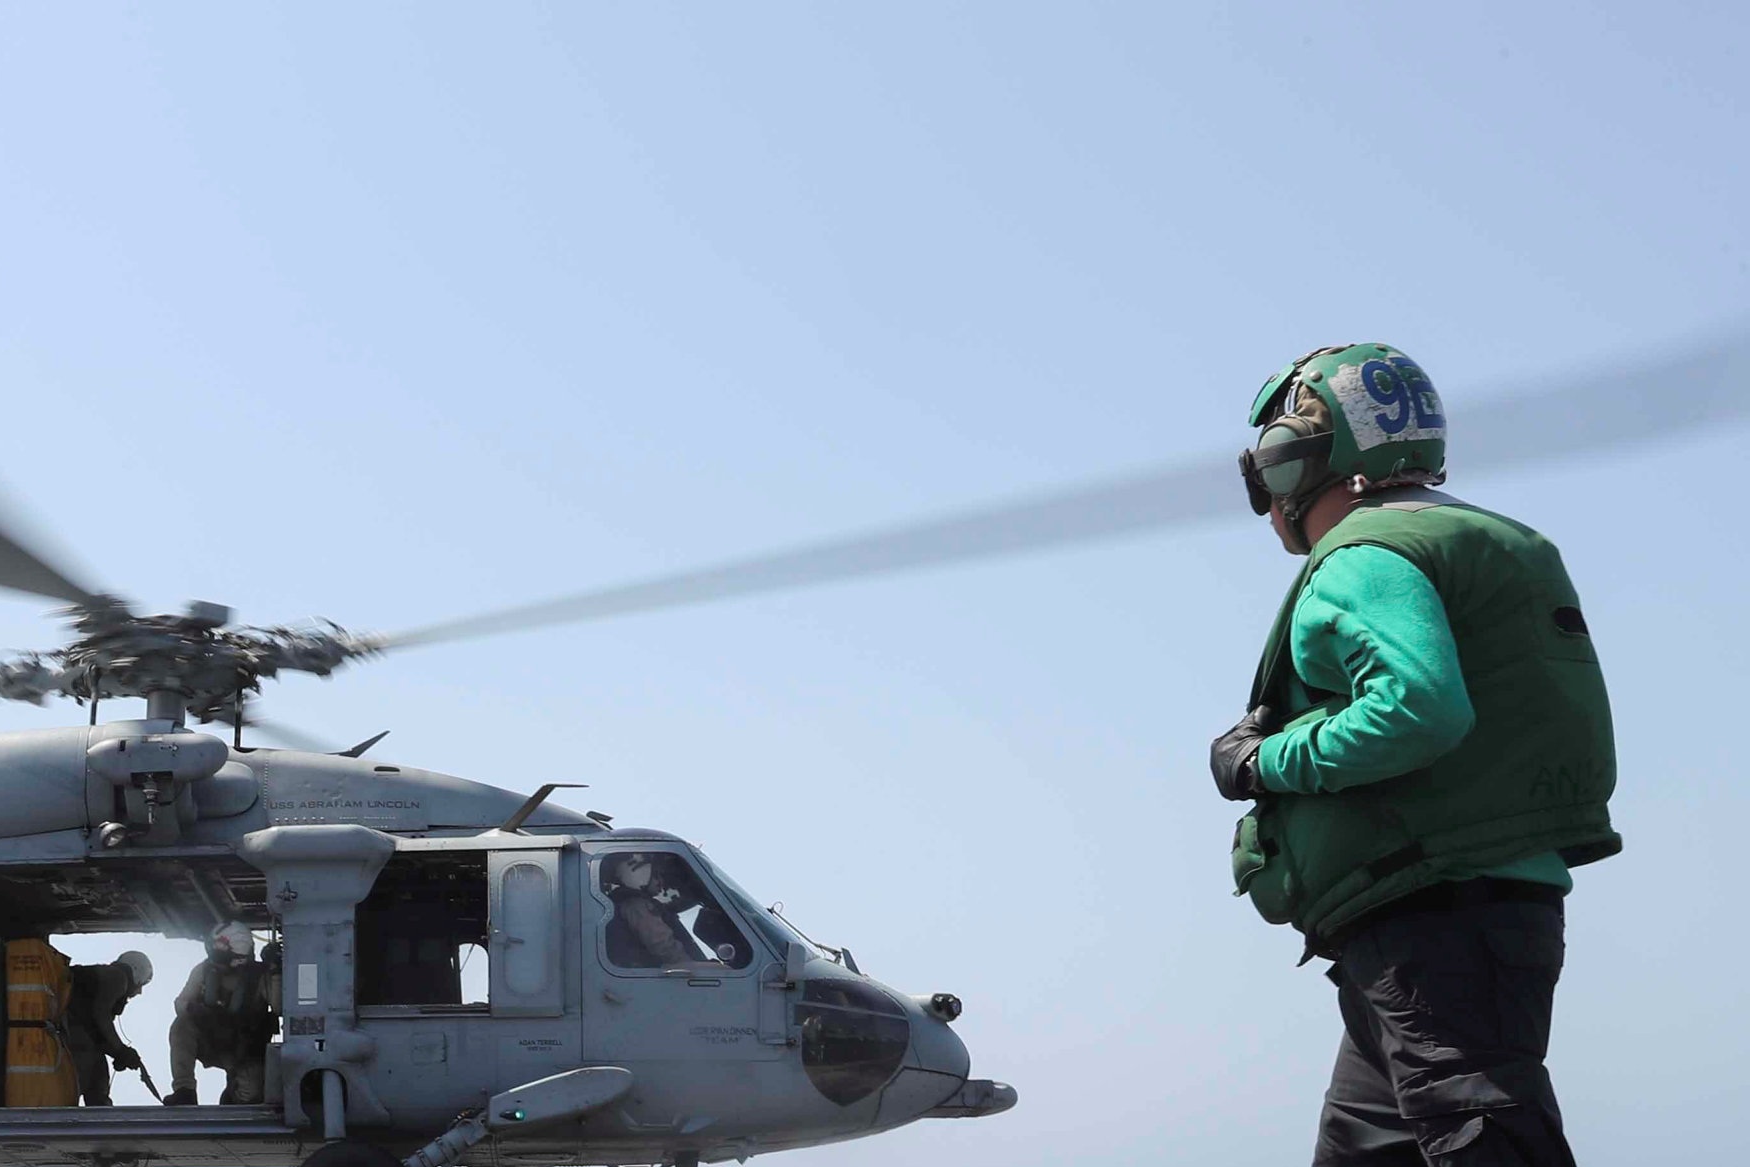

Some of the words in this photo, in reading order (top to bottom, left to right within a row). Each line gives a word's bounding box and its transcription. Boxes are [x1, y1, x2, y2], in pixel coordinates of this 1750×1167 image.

[269, 801, 294, 810] USS
[300, 800, 362, 809] ABRAHAM
[368, 800, 420, 809] LINCOLN
